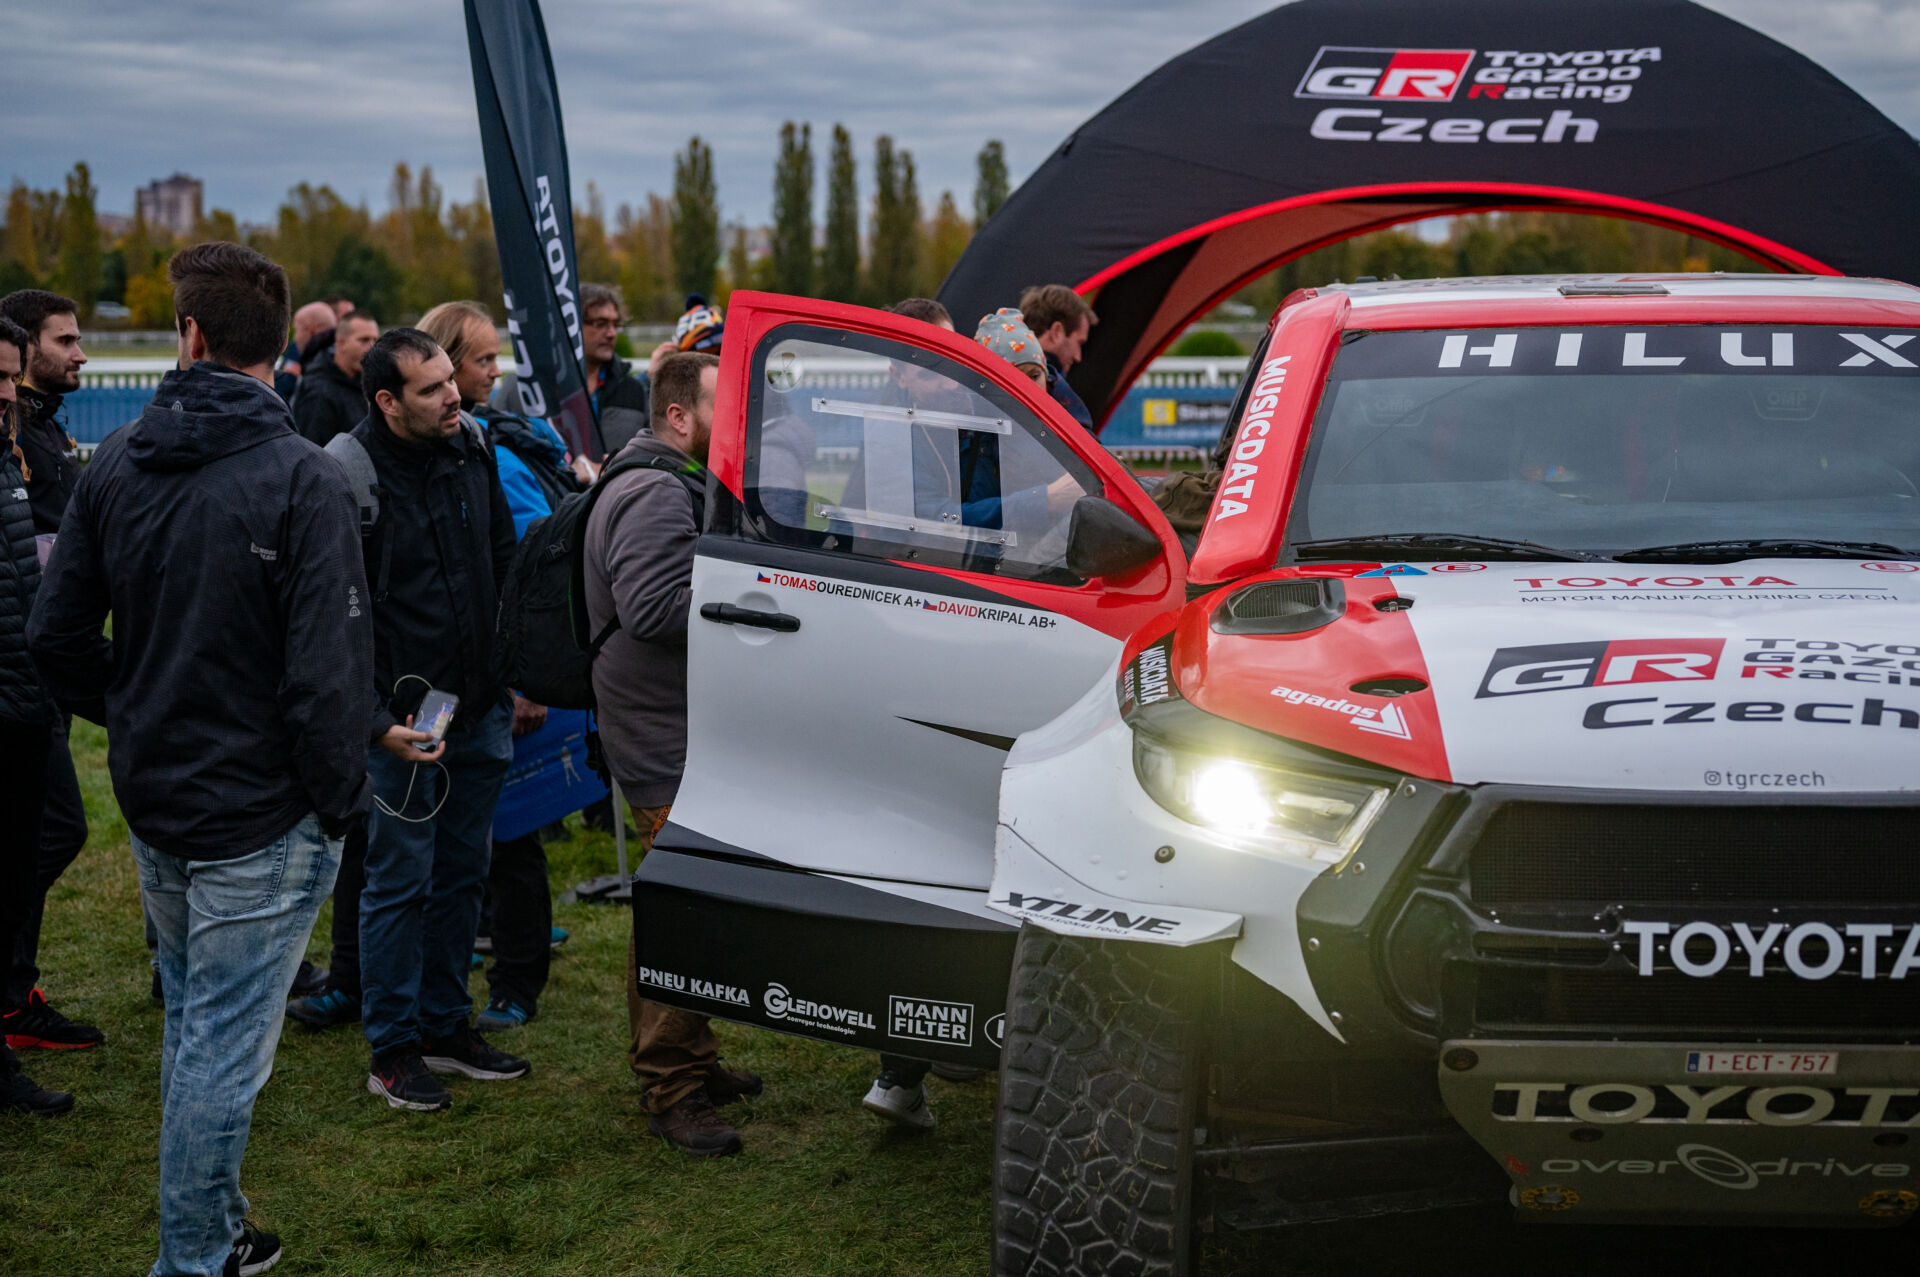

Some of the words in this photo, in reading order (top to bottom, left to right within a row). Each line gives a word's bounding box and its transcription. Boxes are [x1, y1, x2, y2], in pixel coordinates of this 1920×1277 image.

[1484, 47, 1661, 67] TOYOTA
[1306, 66, 1456, 97] GR
[1474, 65, 1642, 83] GAZOO
[1467, 82, 1632, 103] Racing
[1310, 107, 1599, 143] Czech
[1438, 332, 1919, 368] HILUX
[1215, 356, 1292, 522] MUSICDATA
[1513, 576, 1799, 588] TOYOTA
[1521, 595, 1606, 604] MOTOR
[1611, 593, 1812, 602] MANUFACTURING
[1817, 594, 1899, 602] CZECH
[1487, 653, 1713, 694] GR
[1740, 665, 1920, 687] Raci
[1270, 686, 1379, 718] agados
[1583, 697, 1920, 729] Czech
[1725, 770, 1825, 790] tgrczech
[639, 966, 685, 992] PNEU
[690, 979, 750, 1006] KAFKA
[895, 1001, 967, 1023] MANN
[894, 1017, 966, 1040] FILTER
[1707, 1054, 1830, 1071] 1-ECT-757
[1541, 1158, 1680, 1174] over
[1750, 1157, 1911, 1177] drive
